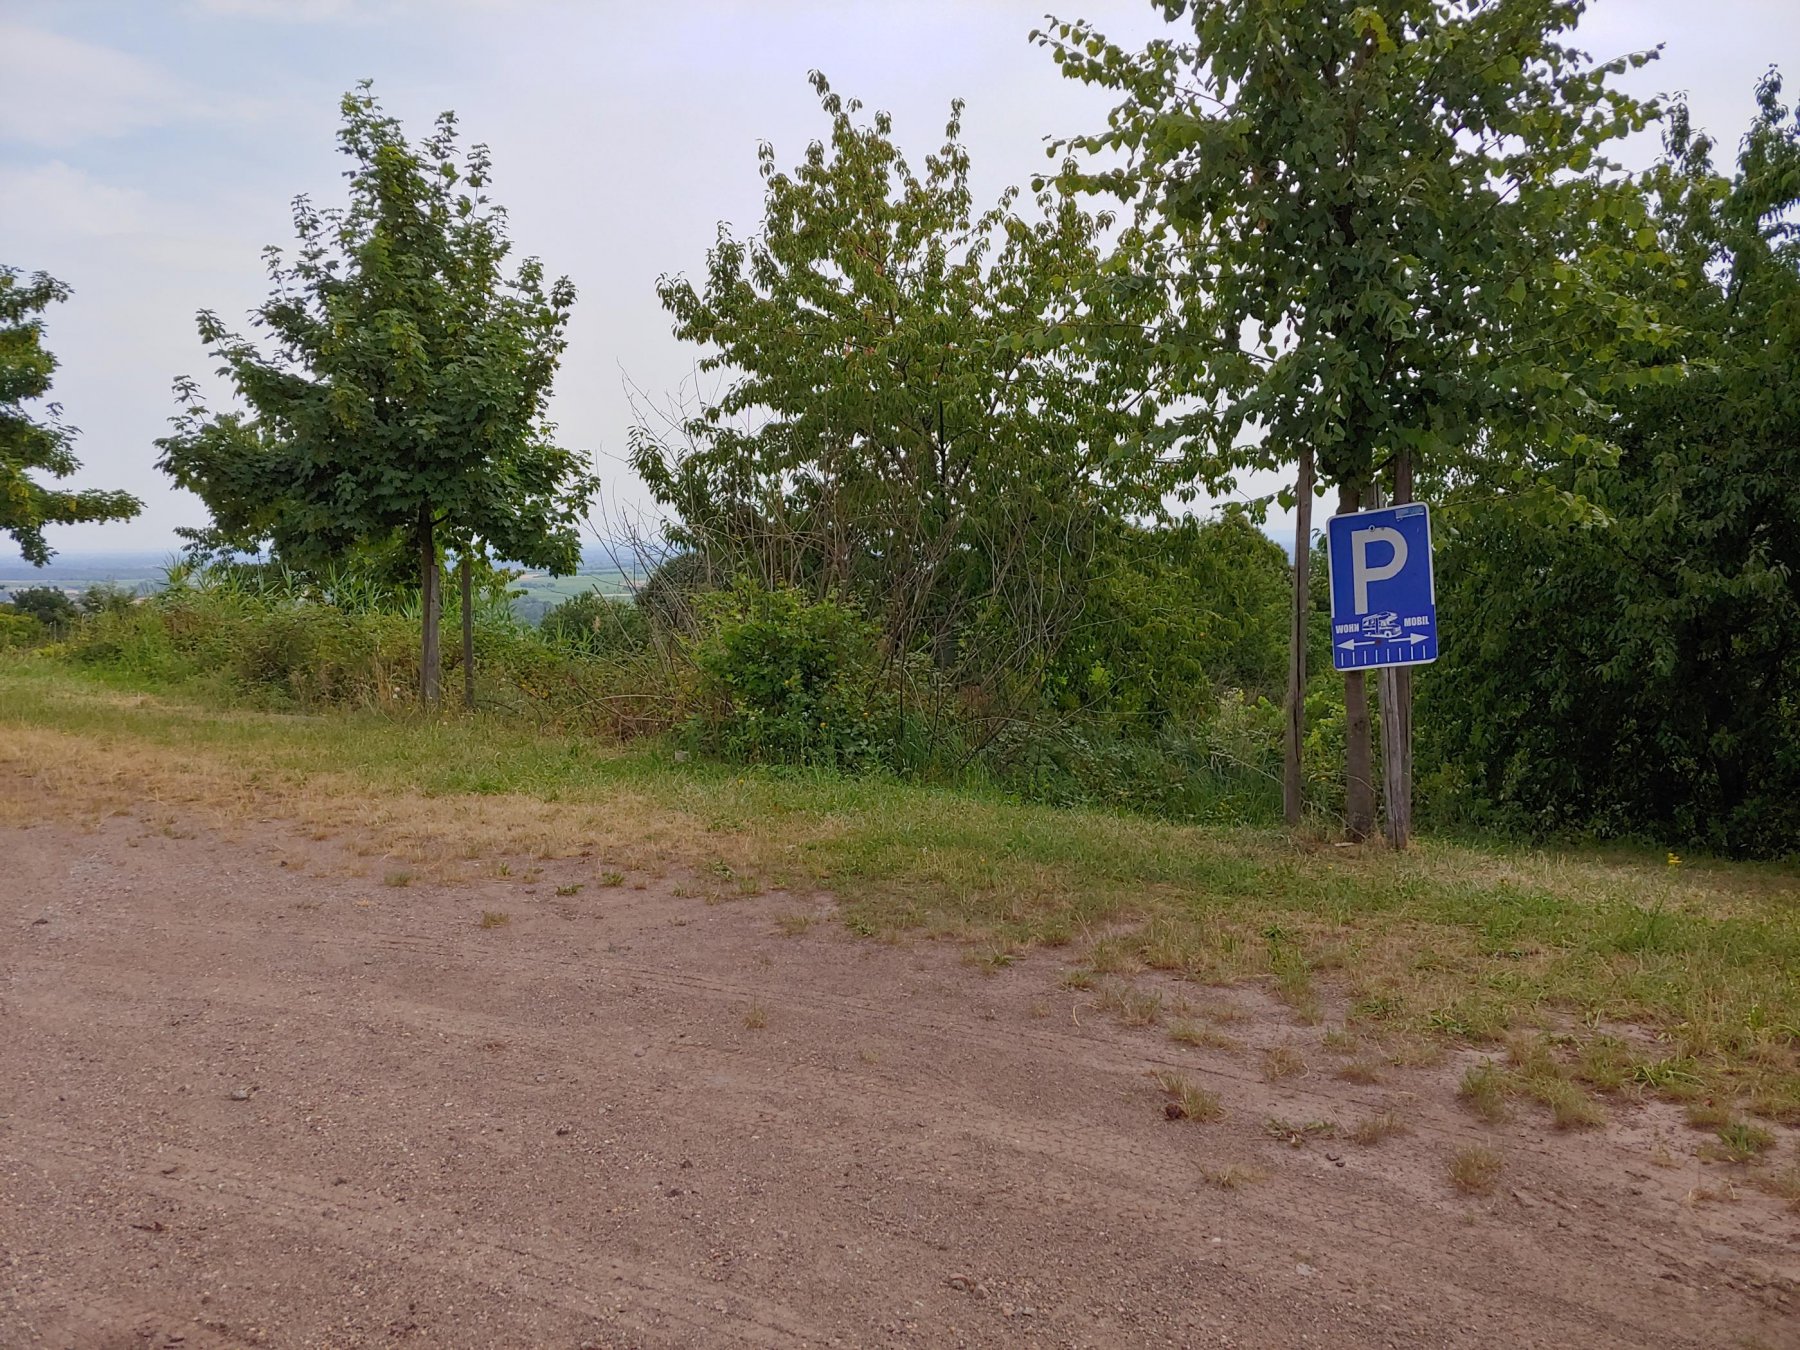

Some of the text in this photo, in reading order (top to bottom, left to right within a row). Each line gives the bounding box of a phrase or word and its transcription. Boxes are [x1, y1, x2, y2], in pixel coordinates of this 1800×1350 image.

[1351, 526, 1408, 615] P
[1335, 615, 1430, 634] WOHN MOBIL
